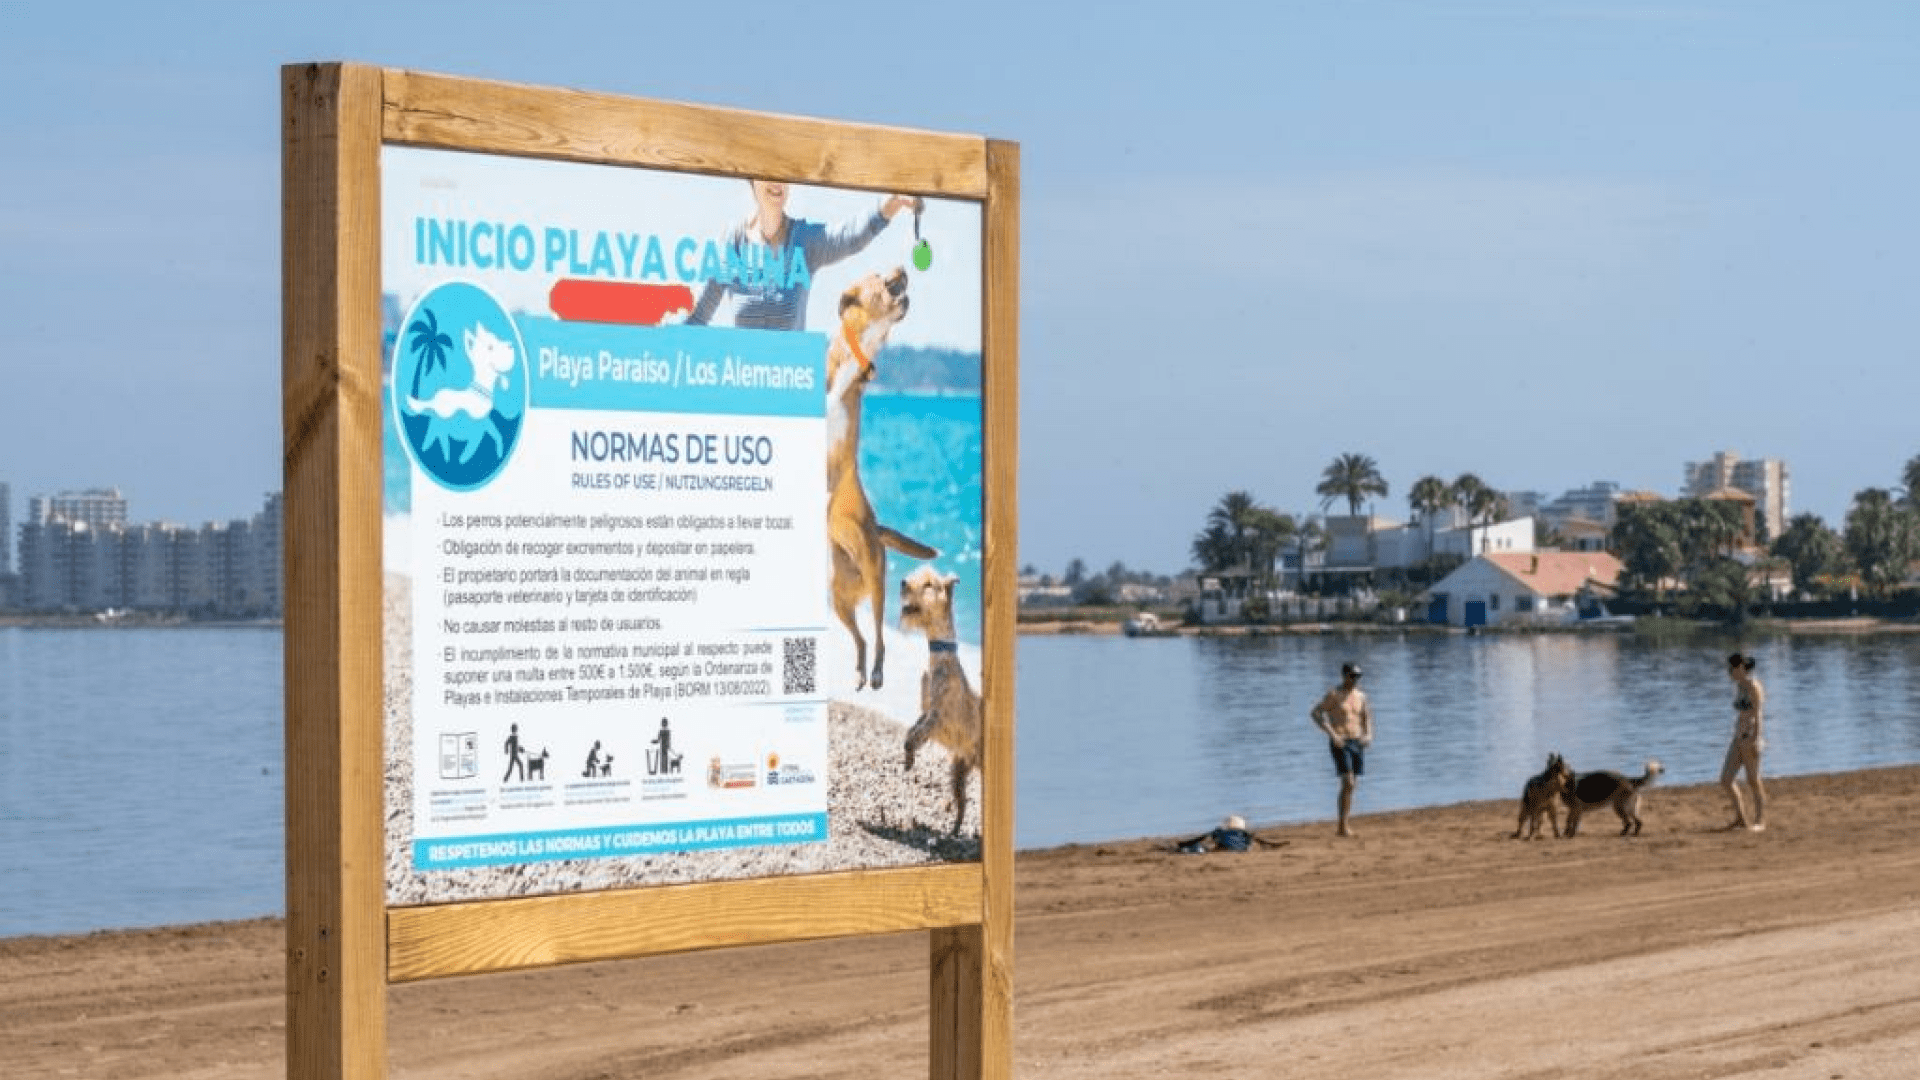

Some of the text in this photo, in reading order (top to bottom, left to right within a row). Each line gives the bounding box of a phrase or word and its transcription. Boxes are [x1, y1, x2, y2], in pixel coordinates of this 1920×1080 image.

[415, 215, 811, 290] INICIO PLAYA CANINA
[539, 347, 593, 388] Playa
[599, 350, 670, 384] Paraíso
[686, 354, 717, 386] Los
[722, 356, 815, 391] Alemanes
[571, 430, 774, 466] NORMAS DE USO
[571, 472, 611, 489] RULES
[613, 473, 631, 489] OF
[634, 474, 656, 490] USE
[665, 475, 773, 492] NUTZUNGSREGELN
[442, 513, 464, 528] Los
[467, 515, 502, 530] perros
[505, 513, 587, 530] potencialmente
[590, 513, 643, 532] peligrosos
[676, 514, 725, 532] obligados
[728, 518, 734, 529] a
[737, 514, 763, 530] llevar
[505, 540, 520, 555] de
[522, 542, 565, 559] recoger
[566, 542, 634, 555] excrementos
[636, 545, 643, 558] y
[646, 541, 693, 558] depositar
[695, 544, 708, 555] en
[443, 567, 455, 583] El
[458, 567, 518, 585] propietario
[561, 567, 571, 582] la
[656, 567, 671, 581] del
[674, 567, 708, 581] animal
[710, 569, 723, 581] en
[725, 566, 751, 584] regla
[444, 589, 503, 607] (pasaporte
[507, 589, 563, 604] veterinario
[565, 592, 572, 607] y
[575, 589, 609, 607] tarjeta
[611, 589, 625, 603] de
[443, 619, 461, 633] No
[463, 620, 501, 633] causar
[503, 618, 556, 632] molestias
[558, 617, 569, 632] al
[570, 618, 599, 631] resto
[601, 617, 614, 631] de
[443, 641, 773, 664] El incumplimiento de la normativa municipal al respecto puede
[443, 671, 490, 688] suponer
[492, 671, 513, 683] una
[515, 667, 545, 682] multa
[547, 668, 574, 681] entre
[578, 664, 606, 680] 500€
[608, 667, 615, 678] a
[693, 662, 702, 676] la
[704, 661, 758, 677] Ordenanza
[760, 660, 773, 674] de
[443, 691, 481, 709] Playas
[494, 688, 563, 704] Instalaciones
[566, 685, 626, 703] Temporales
[627, 683, 641, 698] de
[643, 682, 673, 701] Playa
[429, 818, 815, 861] RESPETEMOS LAS NORMAS Y CUIDEMOS LA PLAYA ENTRE TODOS
